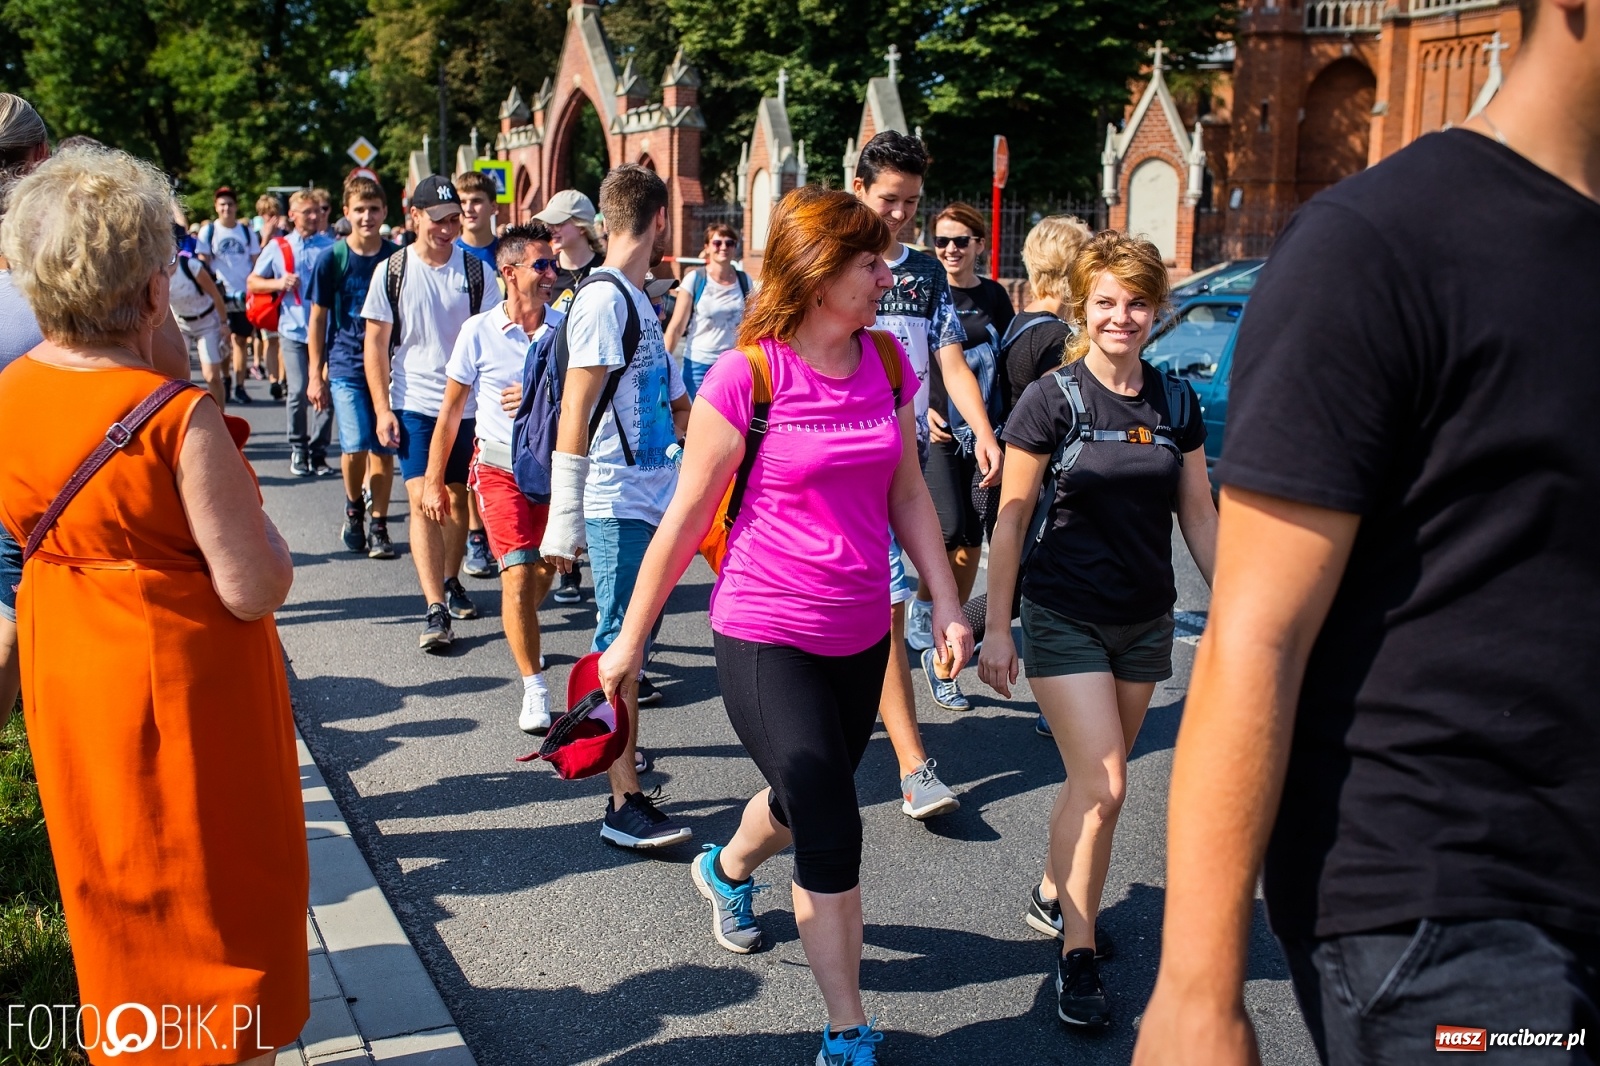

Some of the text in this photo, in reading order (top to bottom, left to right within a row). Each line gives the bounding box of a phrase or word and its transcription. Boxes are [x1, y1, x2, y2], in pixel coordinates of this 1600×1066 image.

[778, 424, 827, 433] FORGET
[833, 423, 854, 433] THE
[859, 415, 893, 430] RULES
